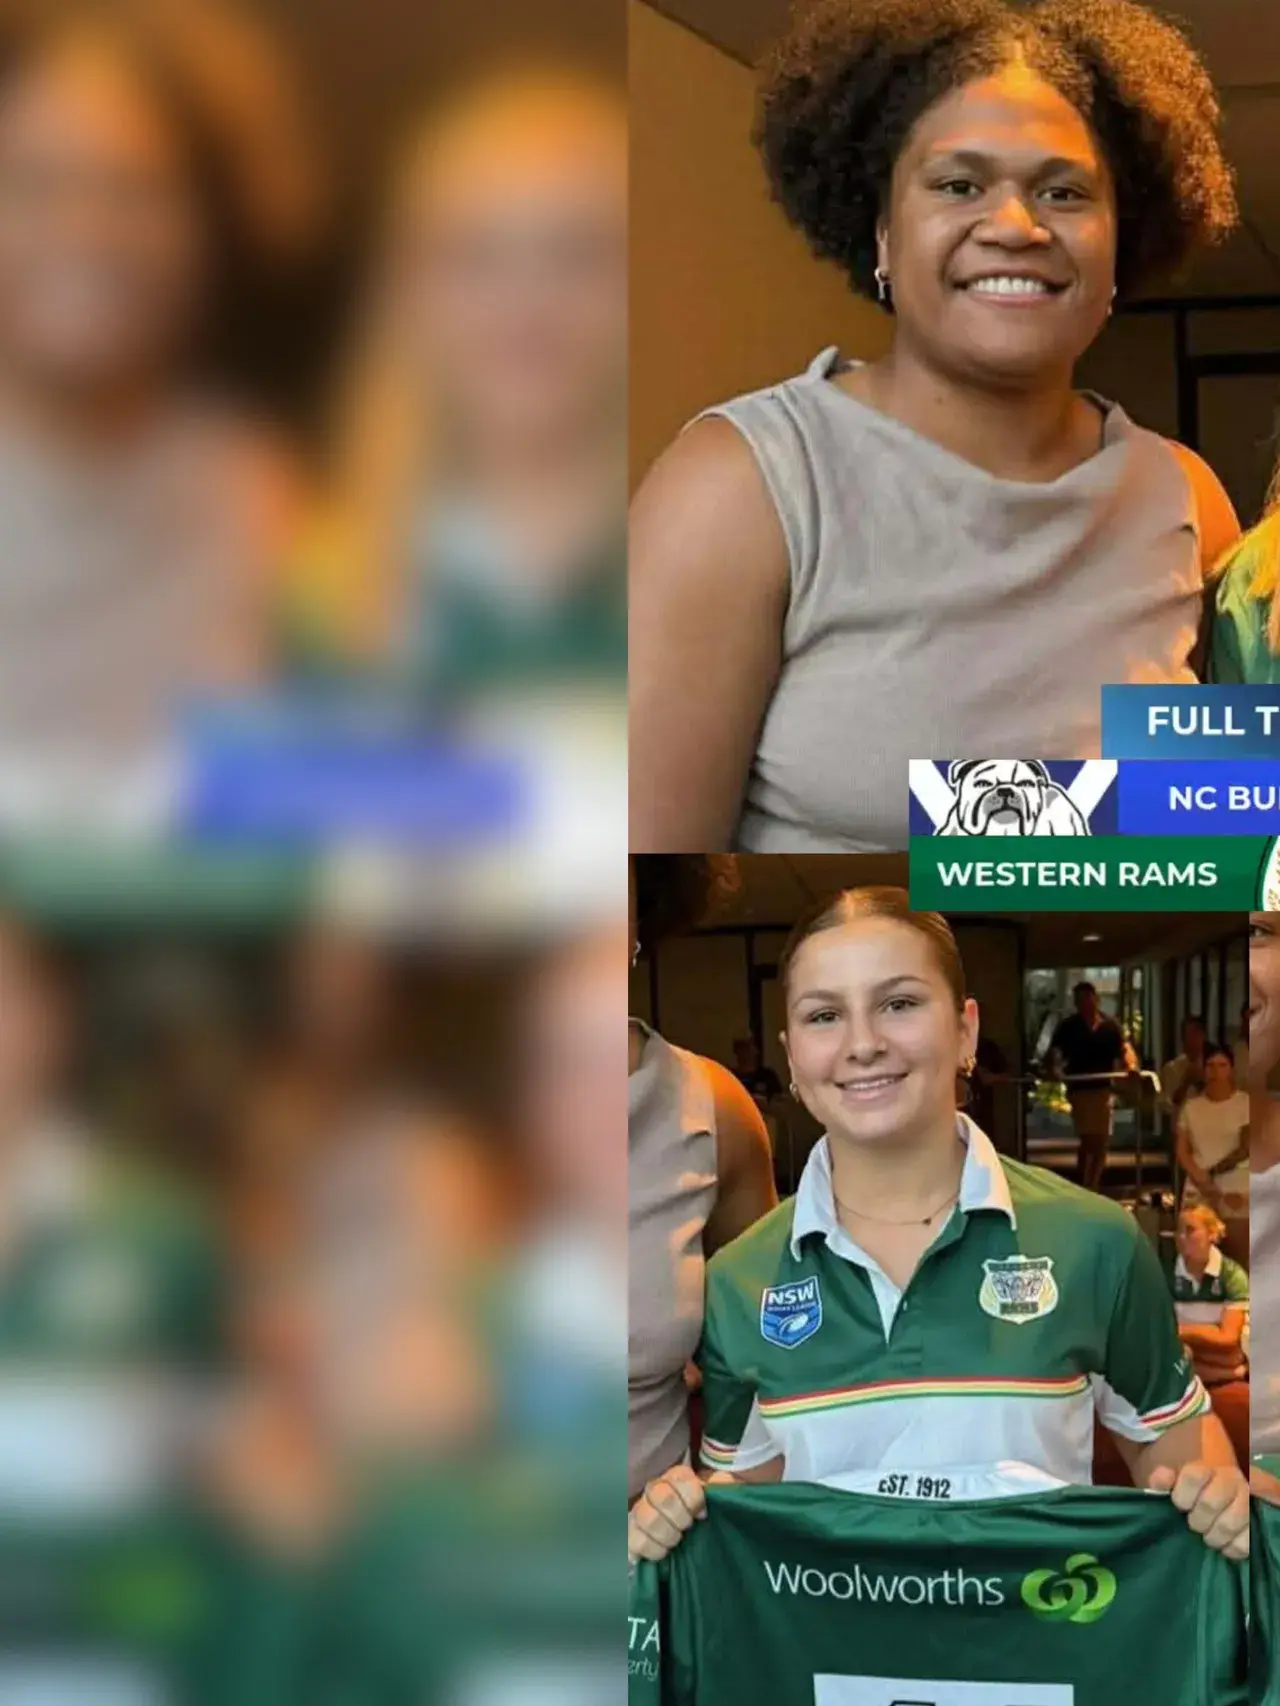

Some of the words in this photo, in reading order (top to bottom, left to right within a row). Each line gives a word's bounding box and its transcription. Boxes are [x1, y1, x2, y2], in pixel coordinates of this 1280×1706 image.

[768, 1282, 814, 1305] NSW
[916, 1476, 951, 1499] 1912
[763, 1560, 1005, 1605] Woolworths
